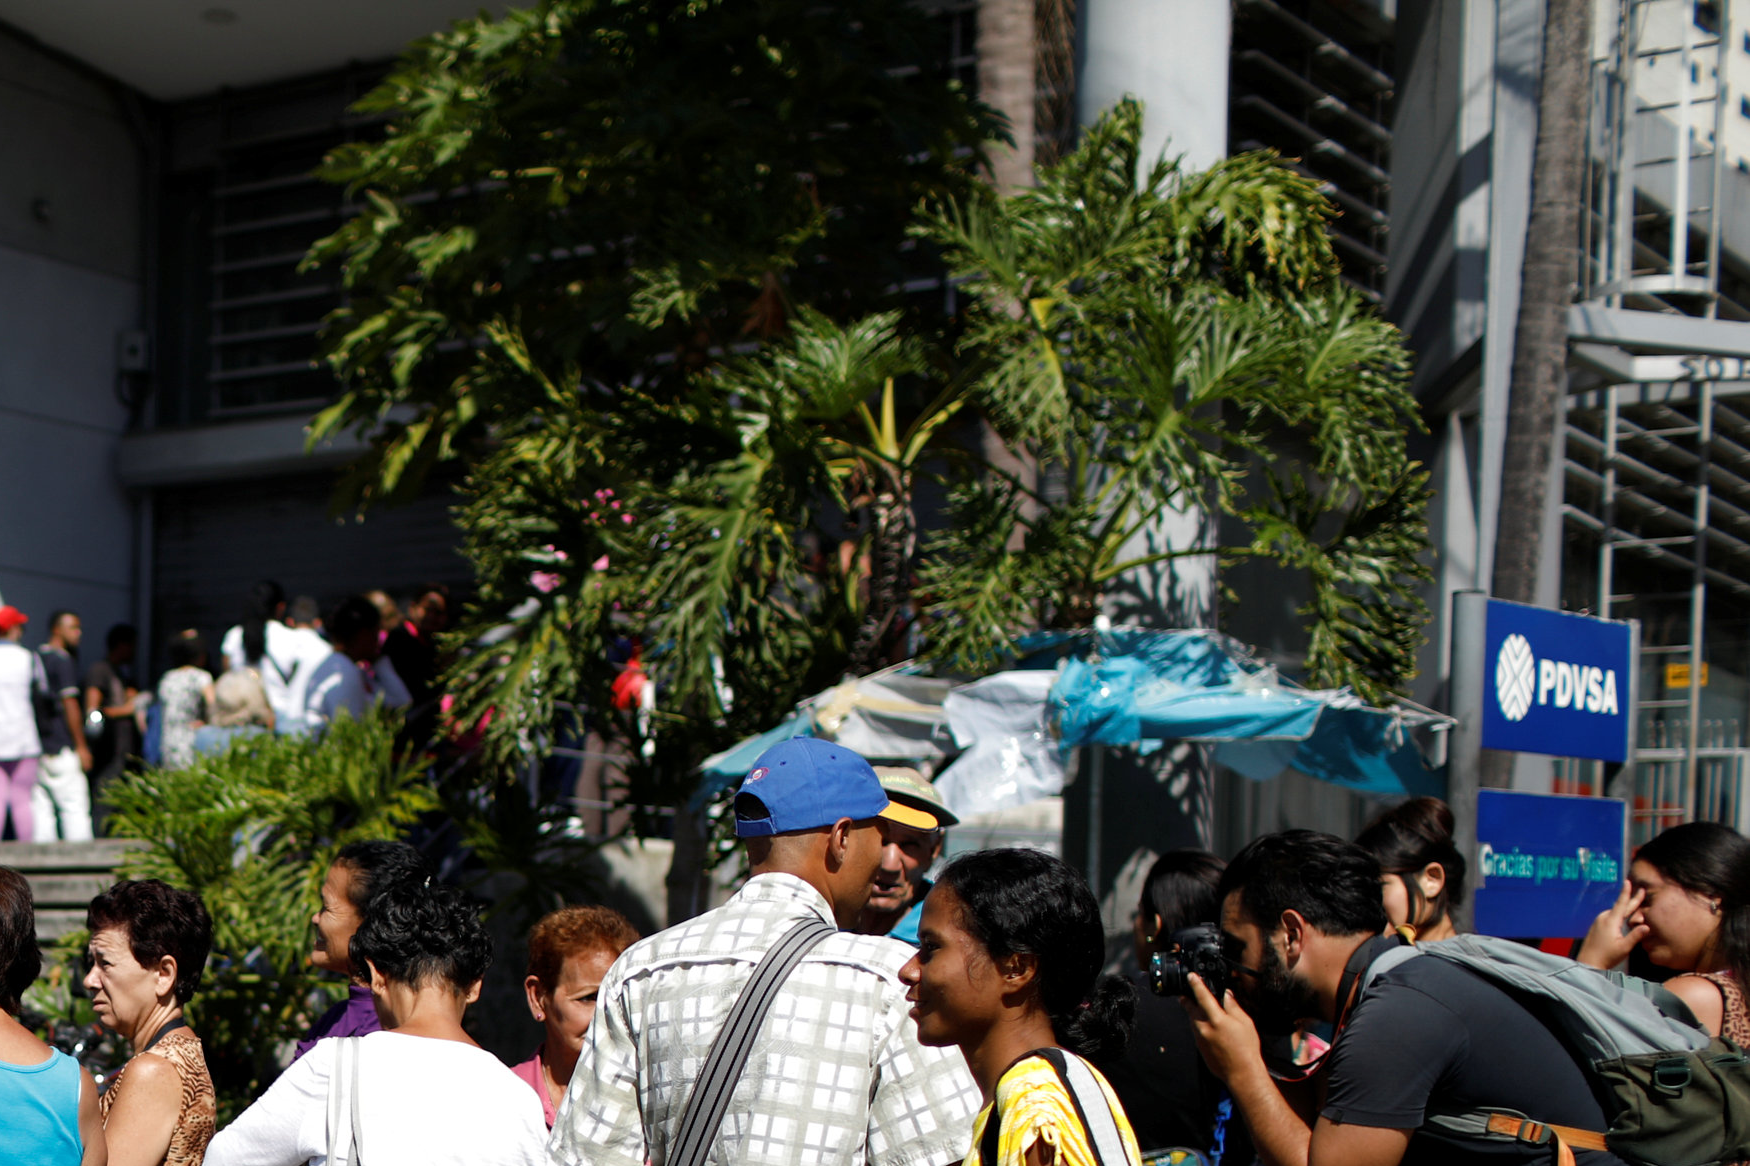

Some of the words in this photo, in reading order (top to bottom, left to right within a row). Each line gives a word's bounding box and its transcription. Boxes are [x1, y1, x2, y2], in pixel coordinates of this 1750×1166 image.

[1538, 659, 1619, 716] PDVSA
[1479, 843, 1534, 878] Gracias
[1534, 855, 1560, 886] por
[1561, 856, 1579, 880] su
